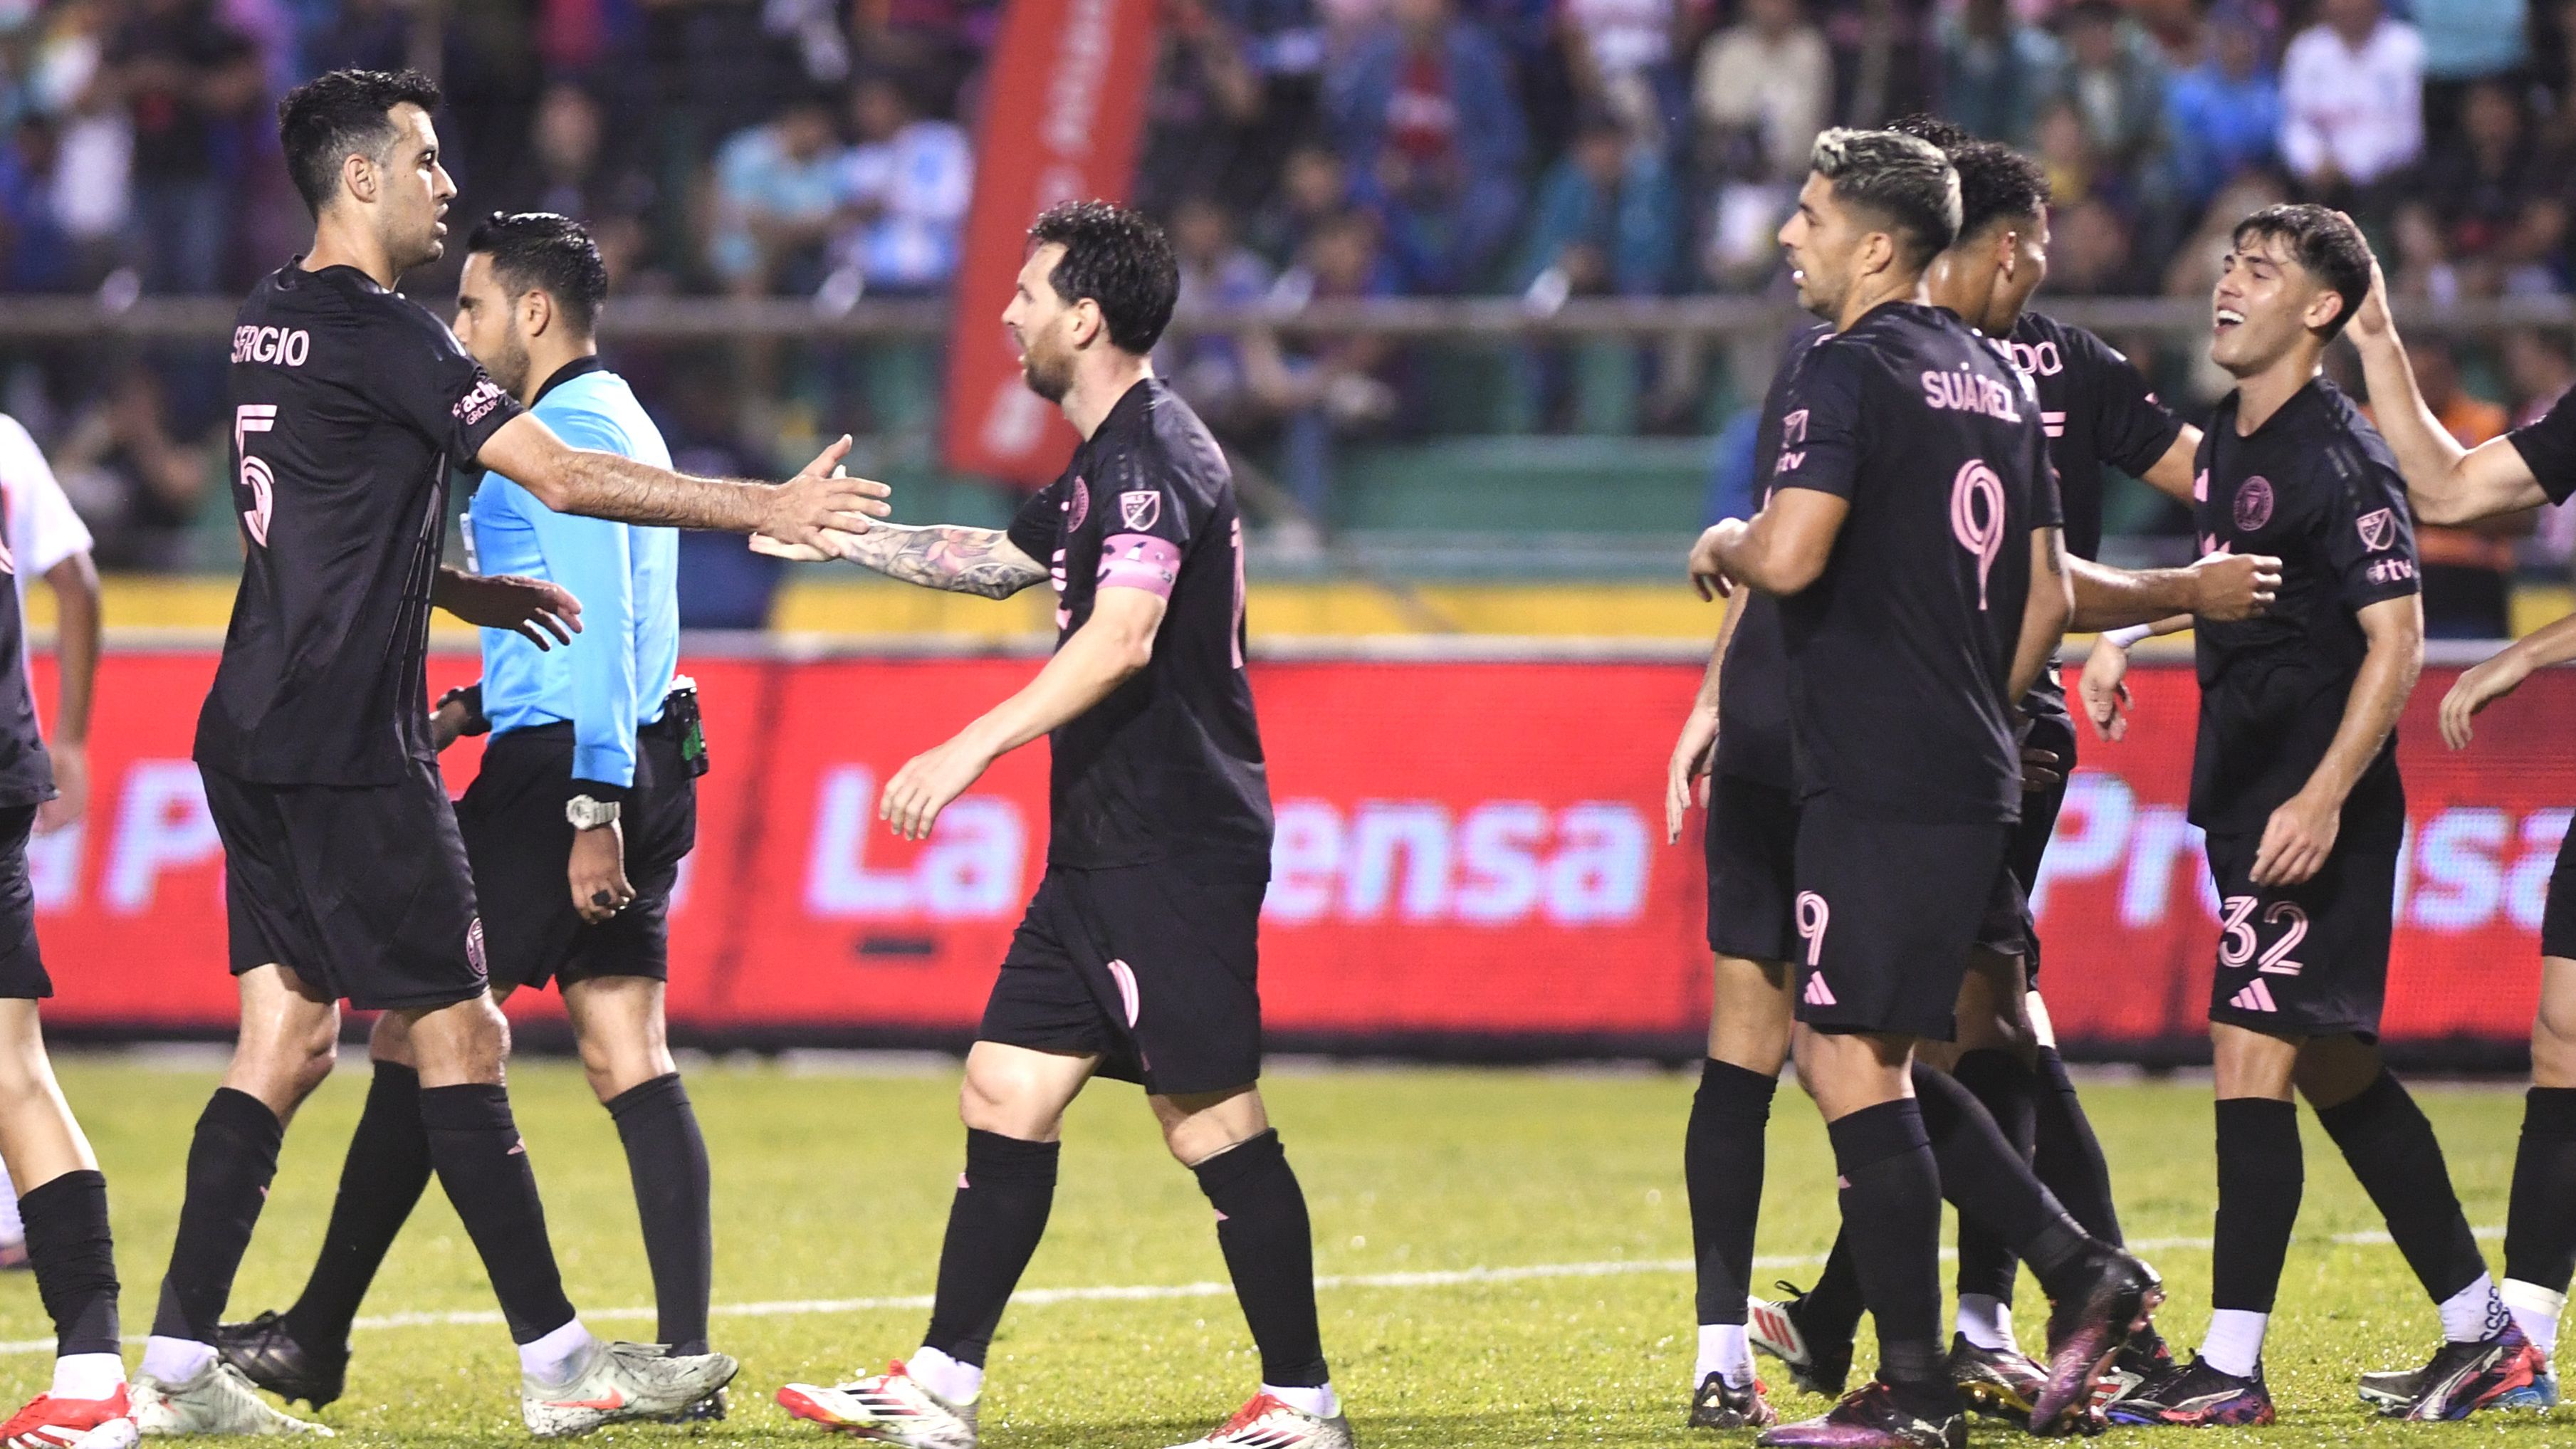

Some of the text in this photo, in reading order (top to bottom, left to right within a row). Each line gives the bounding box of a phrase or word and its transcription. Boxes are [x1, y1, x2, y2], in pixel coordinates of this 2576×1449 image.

[231, 325, 310, 367] SERGIO
[235, 404, 278, 548] 5
[1950, 459, 2005, 611] 9
[805, 762, 1025, 921] La
[1262, 795, 1653, 928] ensa
[1796, 889, 1830, 967] 9
[2219, 895, 2309, 976] 32
